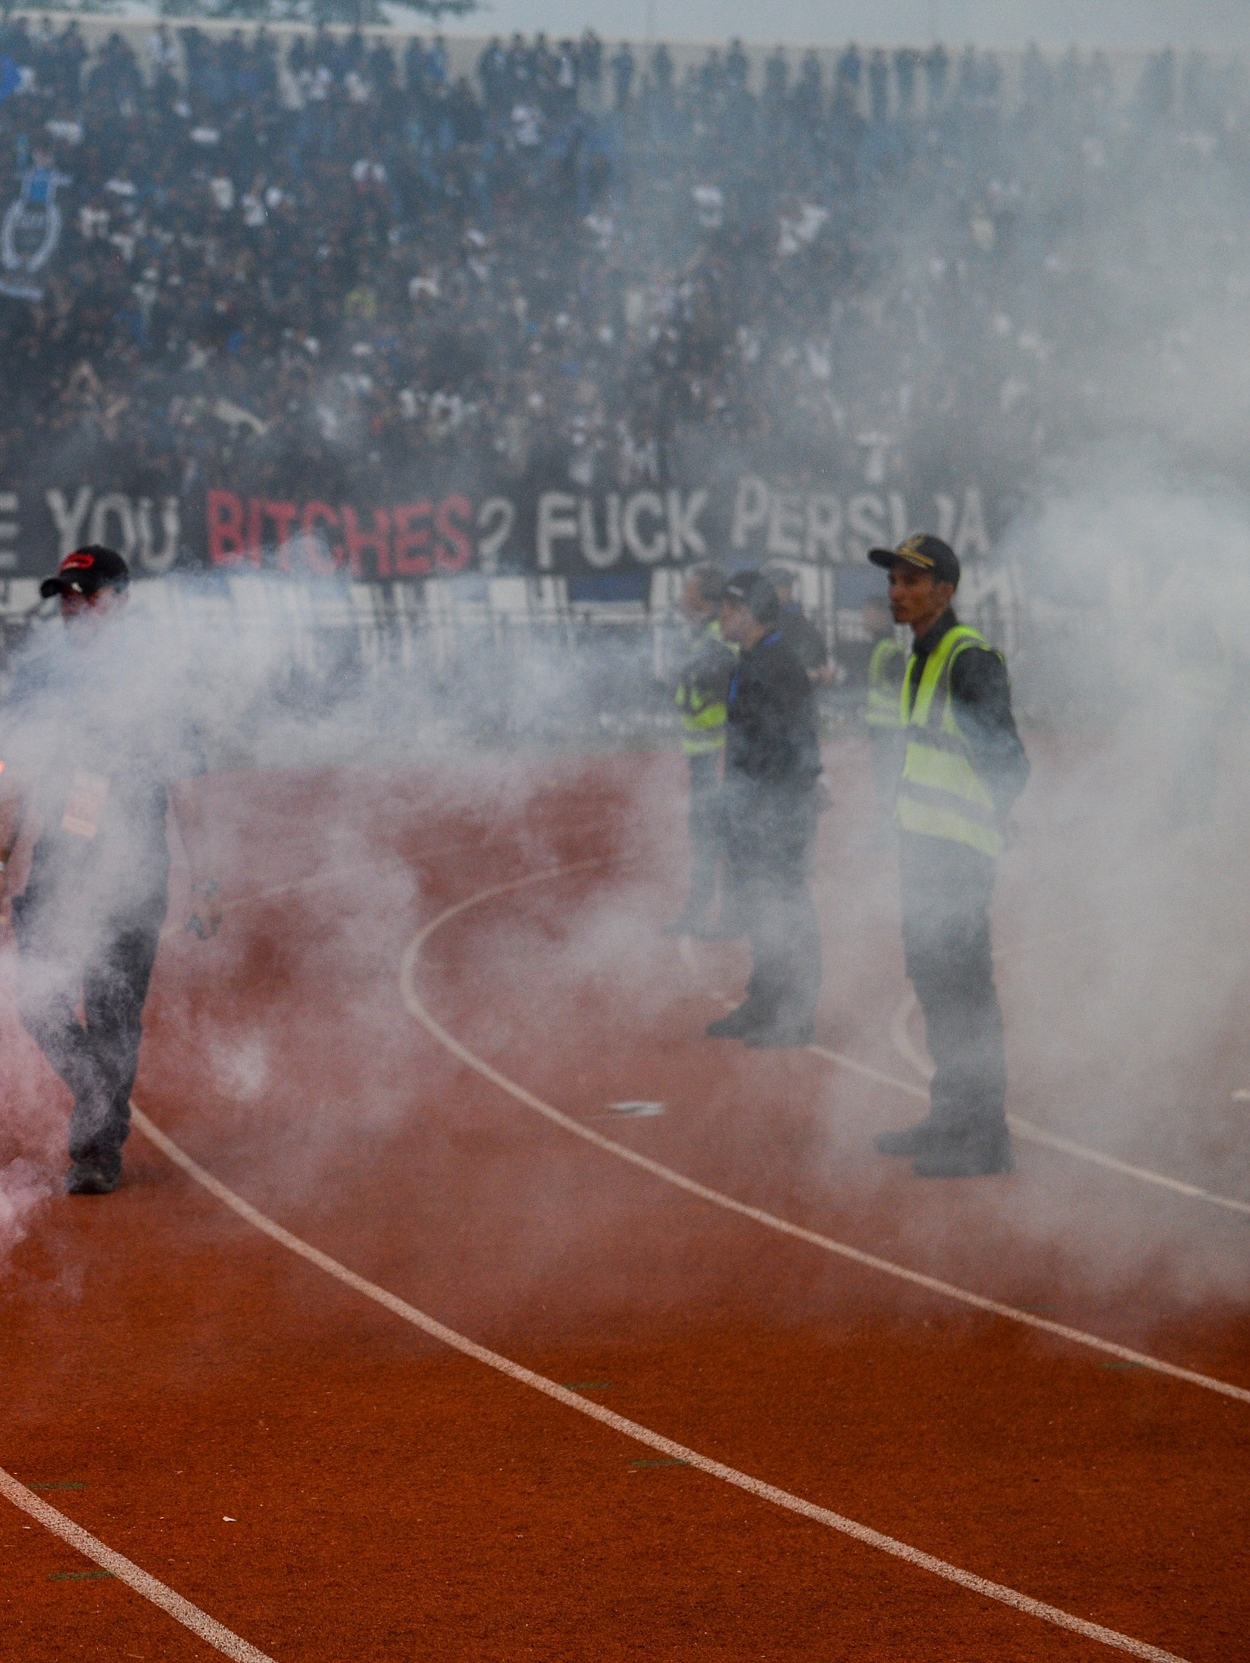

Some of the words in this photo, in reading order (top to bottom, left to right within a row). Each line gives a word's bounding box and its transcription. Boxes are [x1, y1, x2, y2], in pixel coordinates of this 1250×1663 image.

[47, 486, 179, 570] YOU
[207, 488, 514, 577] BITCHES?
[537, 488, 707, 569] FUCK
